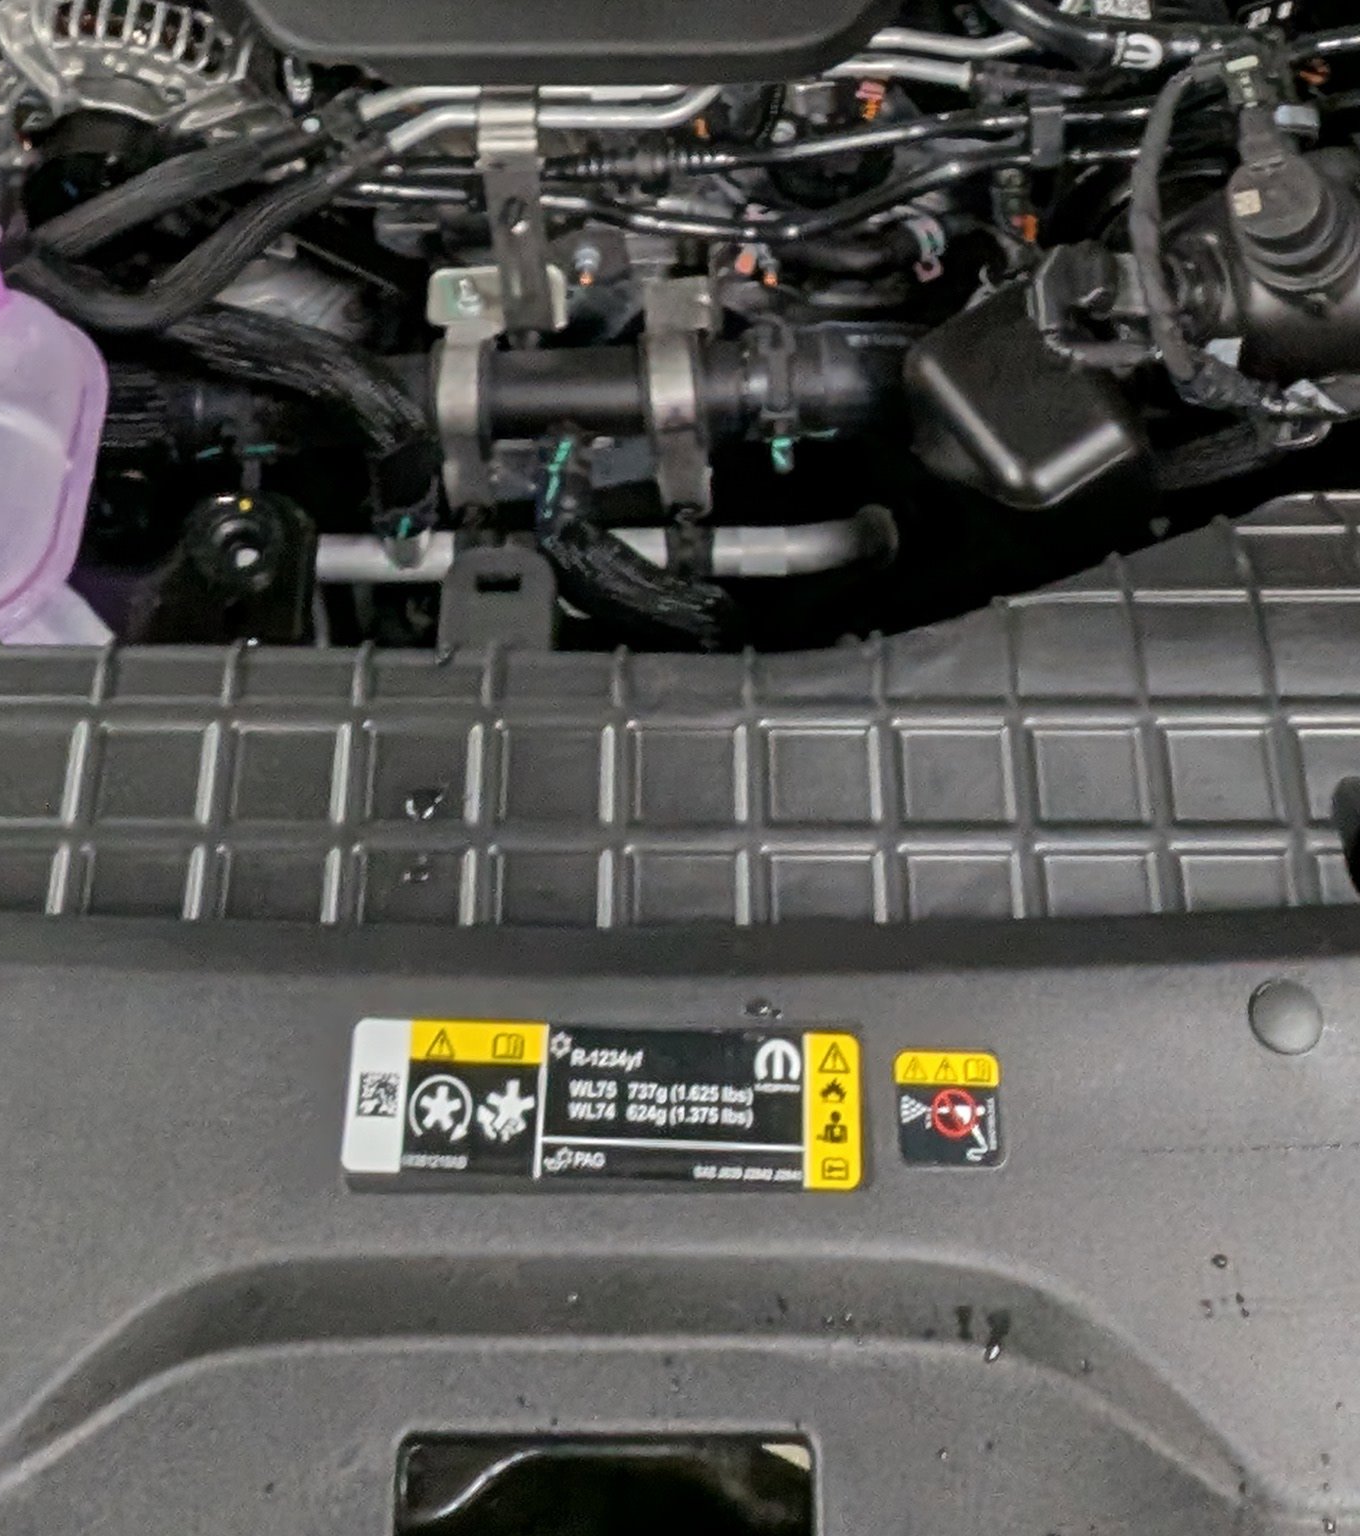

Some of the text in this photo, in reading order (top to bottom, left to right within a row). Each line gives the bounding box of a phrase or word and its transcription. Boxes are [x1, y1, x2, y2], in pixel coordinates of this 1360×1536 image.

[570, 1047, 644, 1072] R-1234yf
[568, 1079, 618, 1099] WL75
[627, 1081, 668, 1104] 737g
[669, 1083, 720, 1105] (1.625
[721, 1085, 754, 1106] lbs)
[567, 1101, 754, 1129] WL74 624g (1.375 lbs)
[571, 1151, 606, 1169] PAG
